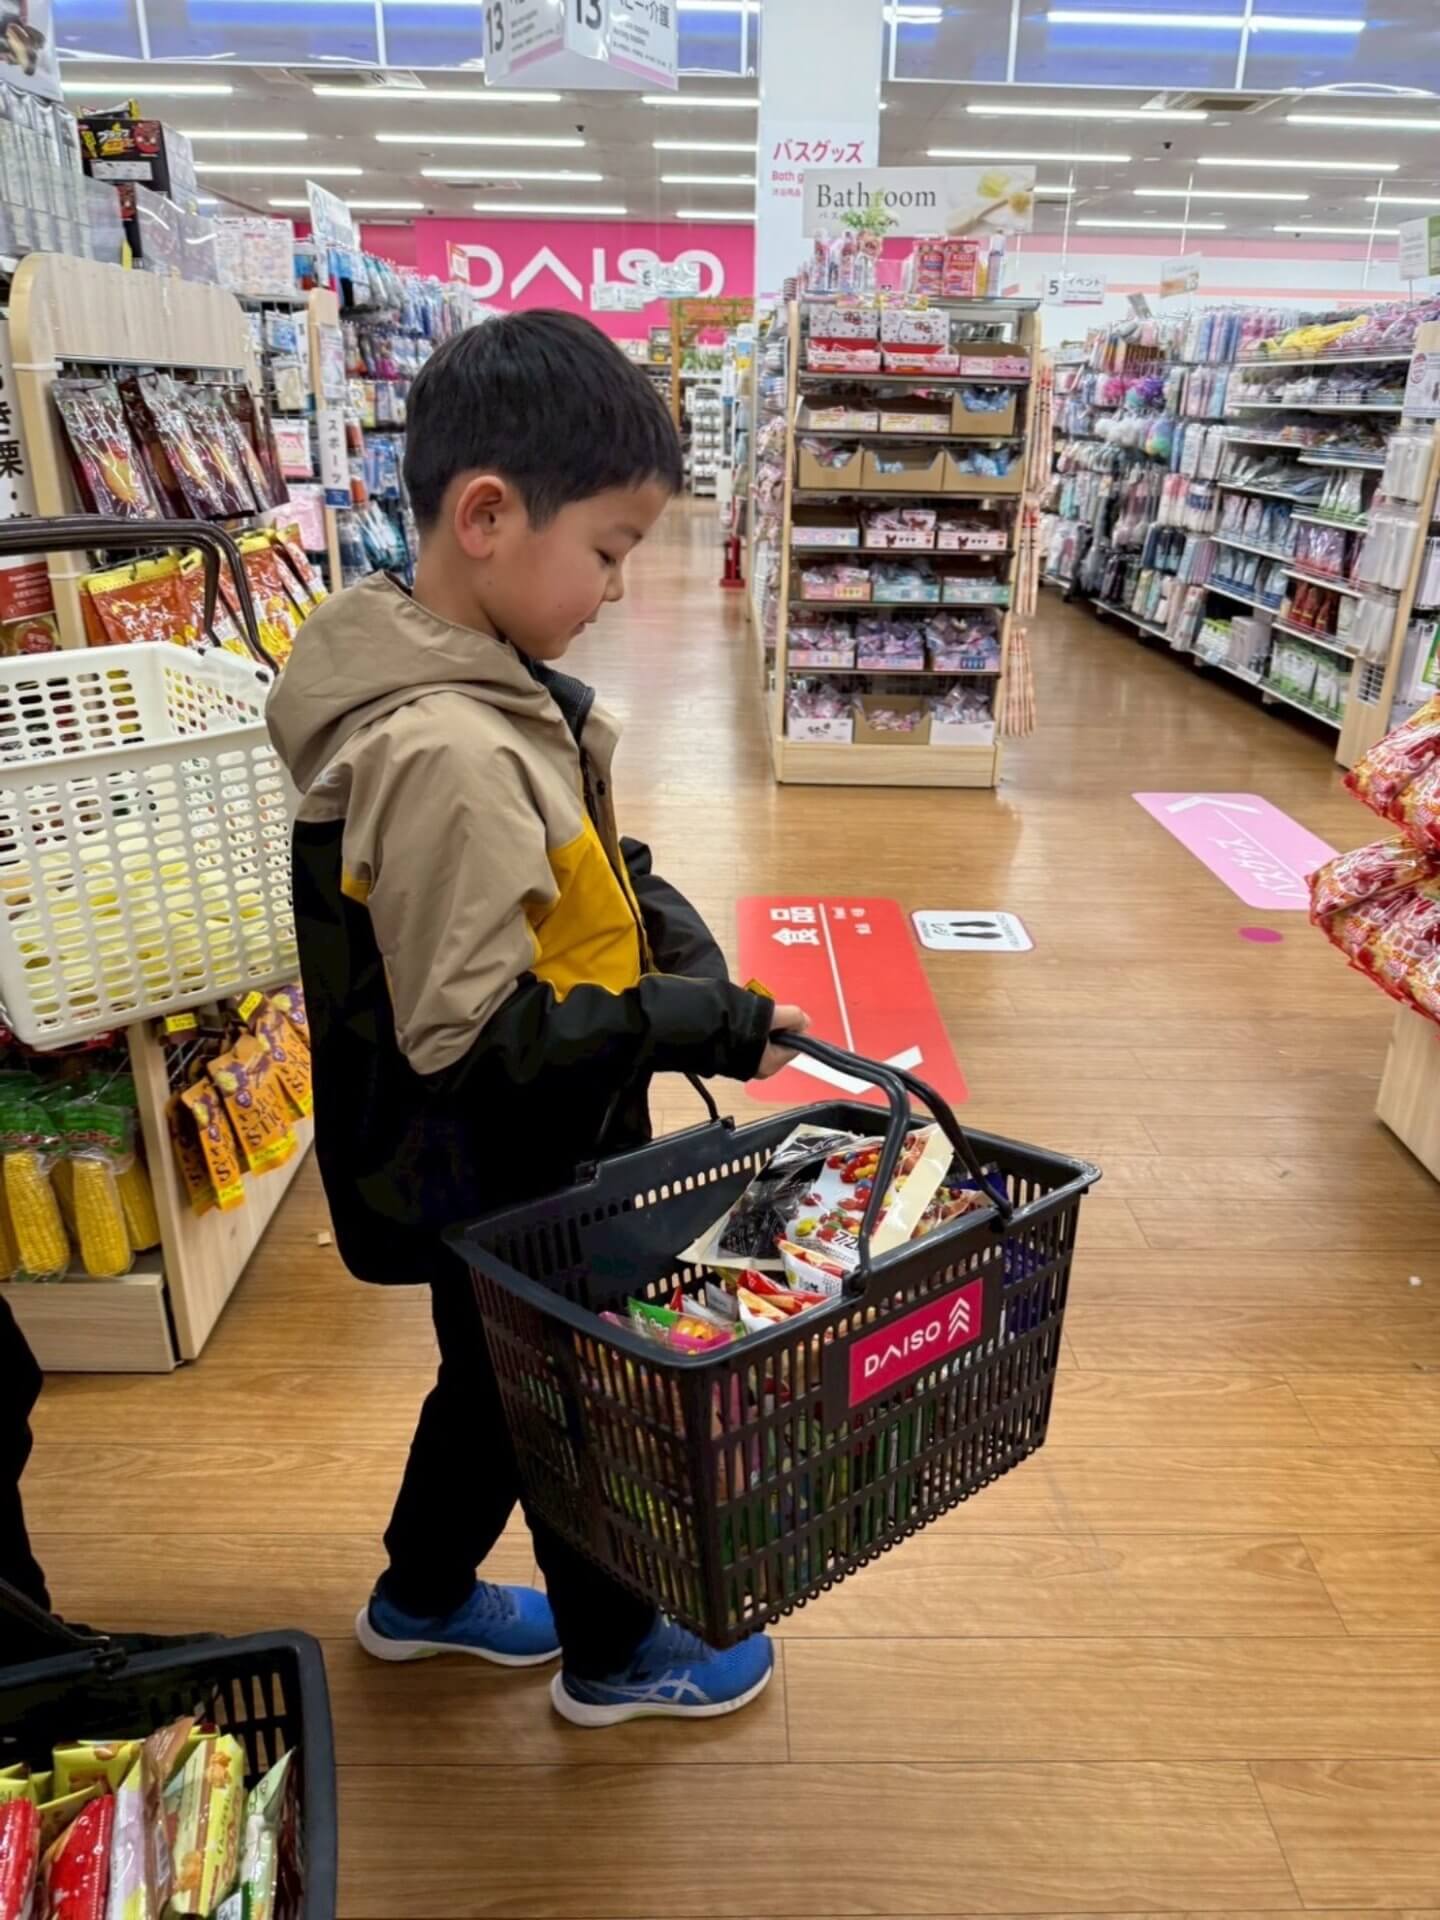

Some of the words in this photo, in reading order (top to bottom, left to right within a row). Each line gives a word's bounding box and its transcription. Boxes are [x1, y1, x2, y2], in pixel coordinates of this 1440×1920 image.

[486, 3, 505, 53] 13
[576, 0, 602, 30] 13
[773, 138, 865, 163] バスグッズ
[771, 170, 795, 181] Bath
[449, 245, 724, 303] DAISO
[1048, 280, 1059, 296] 5
[770, 906, 820, 946] 食品
[864, 1320, 941, 1378] DAISO
